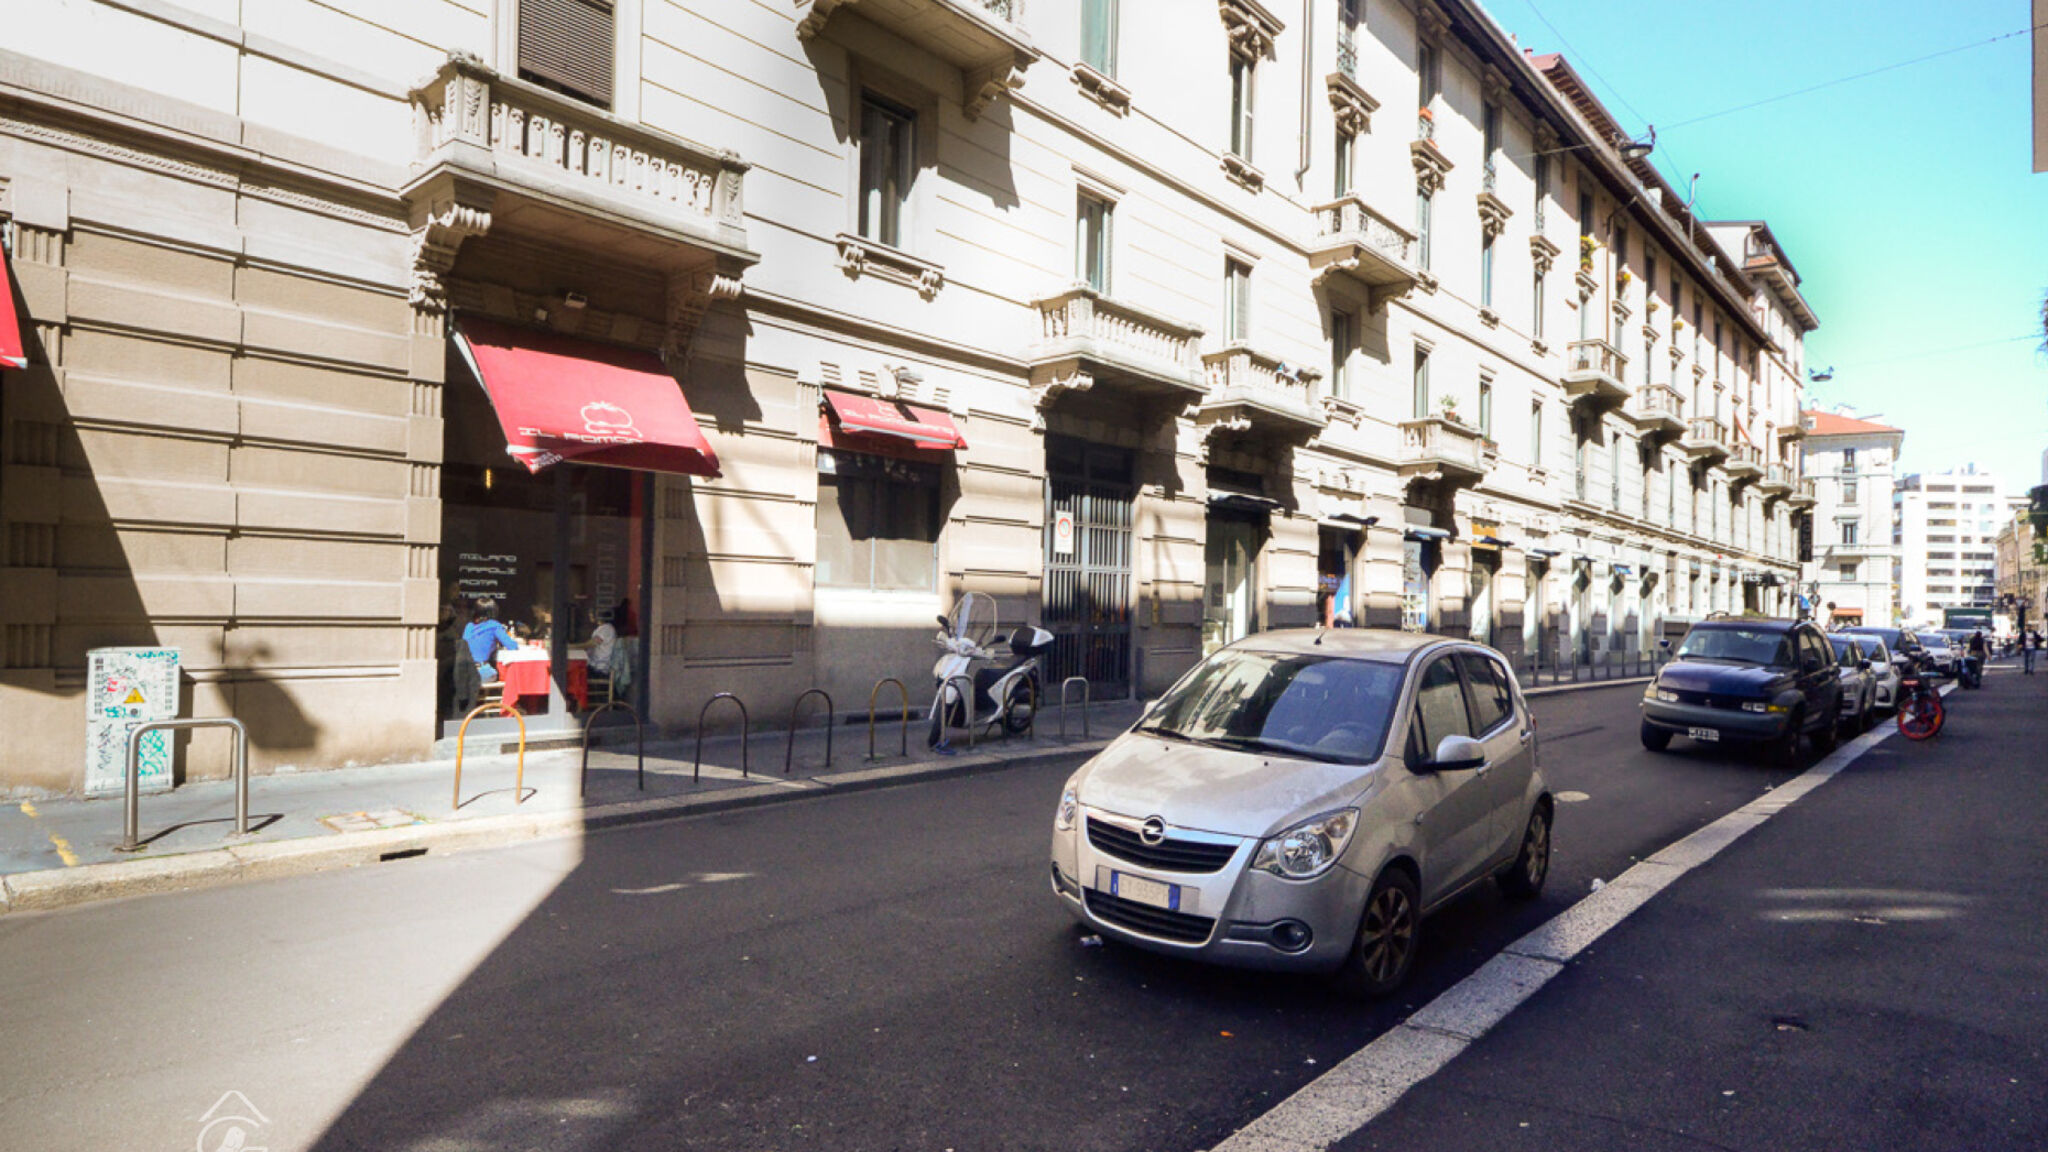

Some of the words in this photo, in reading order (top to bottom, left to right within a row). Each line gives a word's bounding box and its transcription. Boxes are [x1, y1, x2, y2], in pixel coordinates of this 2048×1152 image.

[459, 552, 517, 563] MILANO
[459, 565, 518, 576] NAPOLI
[459, 578, 498, 587] ROMA
[459, 591, 507, 600] TERNI
